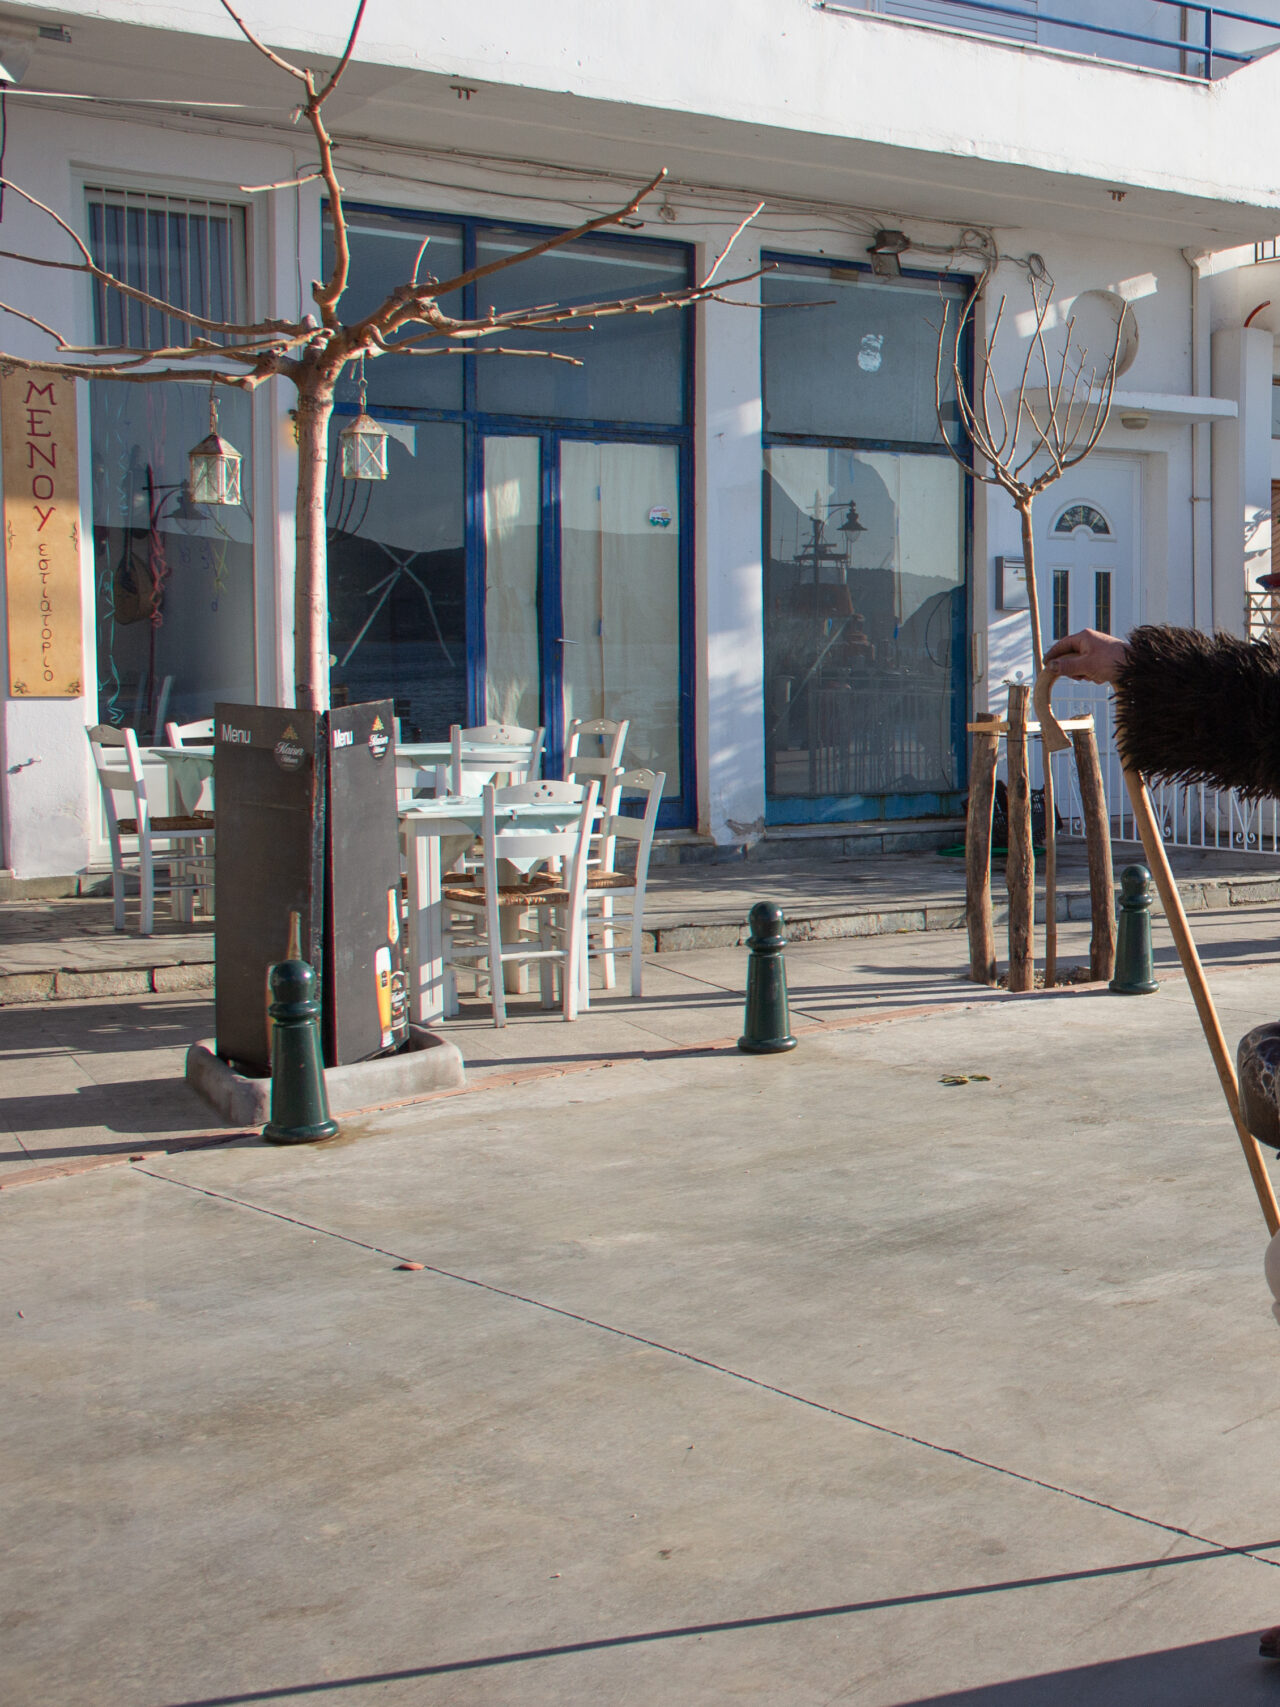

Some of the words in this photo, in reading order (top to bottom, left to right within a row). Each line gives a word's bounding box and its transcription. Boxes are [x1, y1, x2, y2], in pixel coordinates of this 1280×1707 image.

[23, 380, 57, 532] ΜΕΝΟΥ
[221, 723, 251, 744] Menu
[333, 728, 354, 748] Menu
